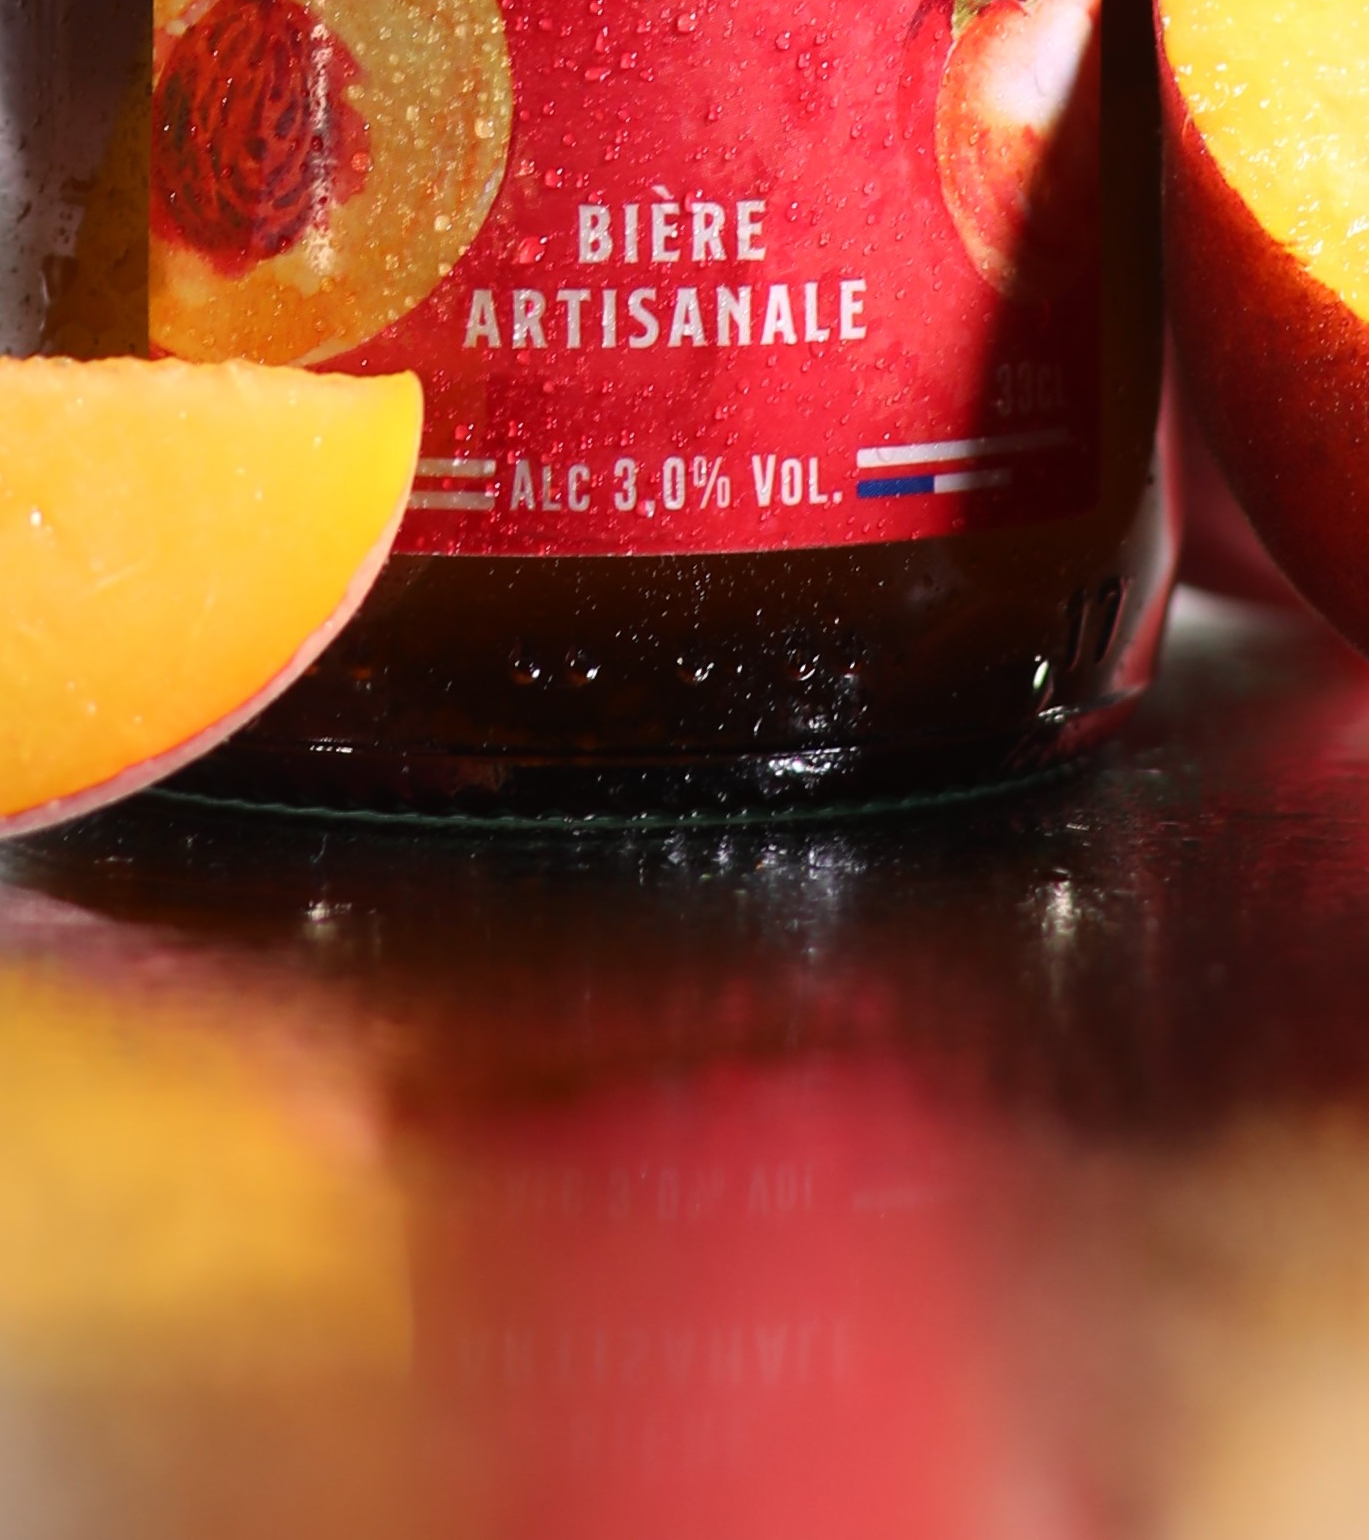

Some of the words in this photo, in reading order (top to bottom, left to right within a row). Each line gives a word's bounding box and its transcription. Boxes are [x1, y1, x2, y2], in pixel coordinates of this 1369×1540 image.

[577, 185, 769, 264] BIÈRE
[462, 279, 869, 350] ARTISANALE
[509, 457, 592, 512] ALC
[613, 455, 732, 518] 3,0%
[751, 453, 844, 509] VOL.
